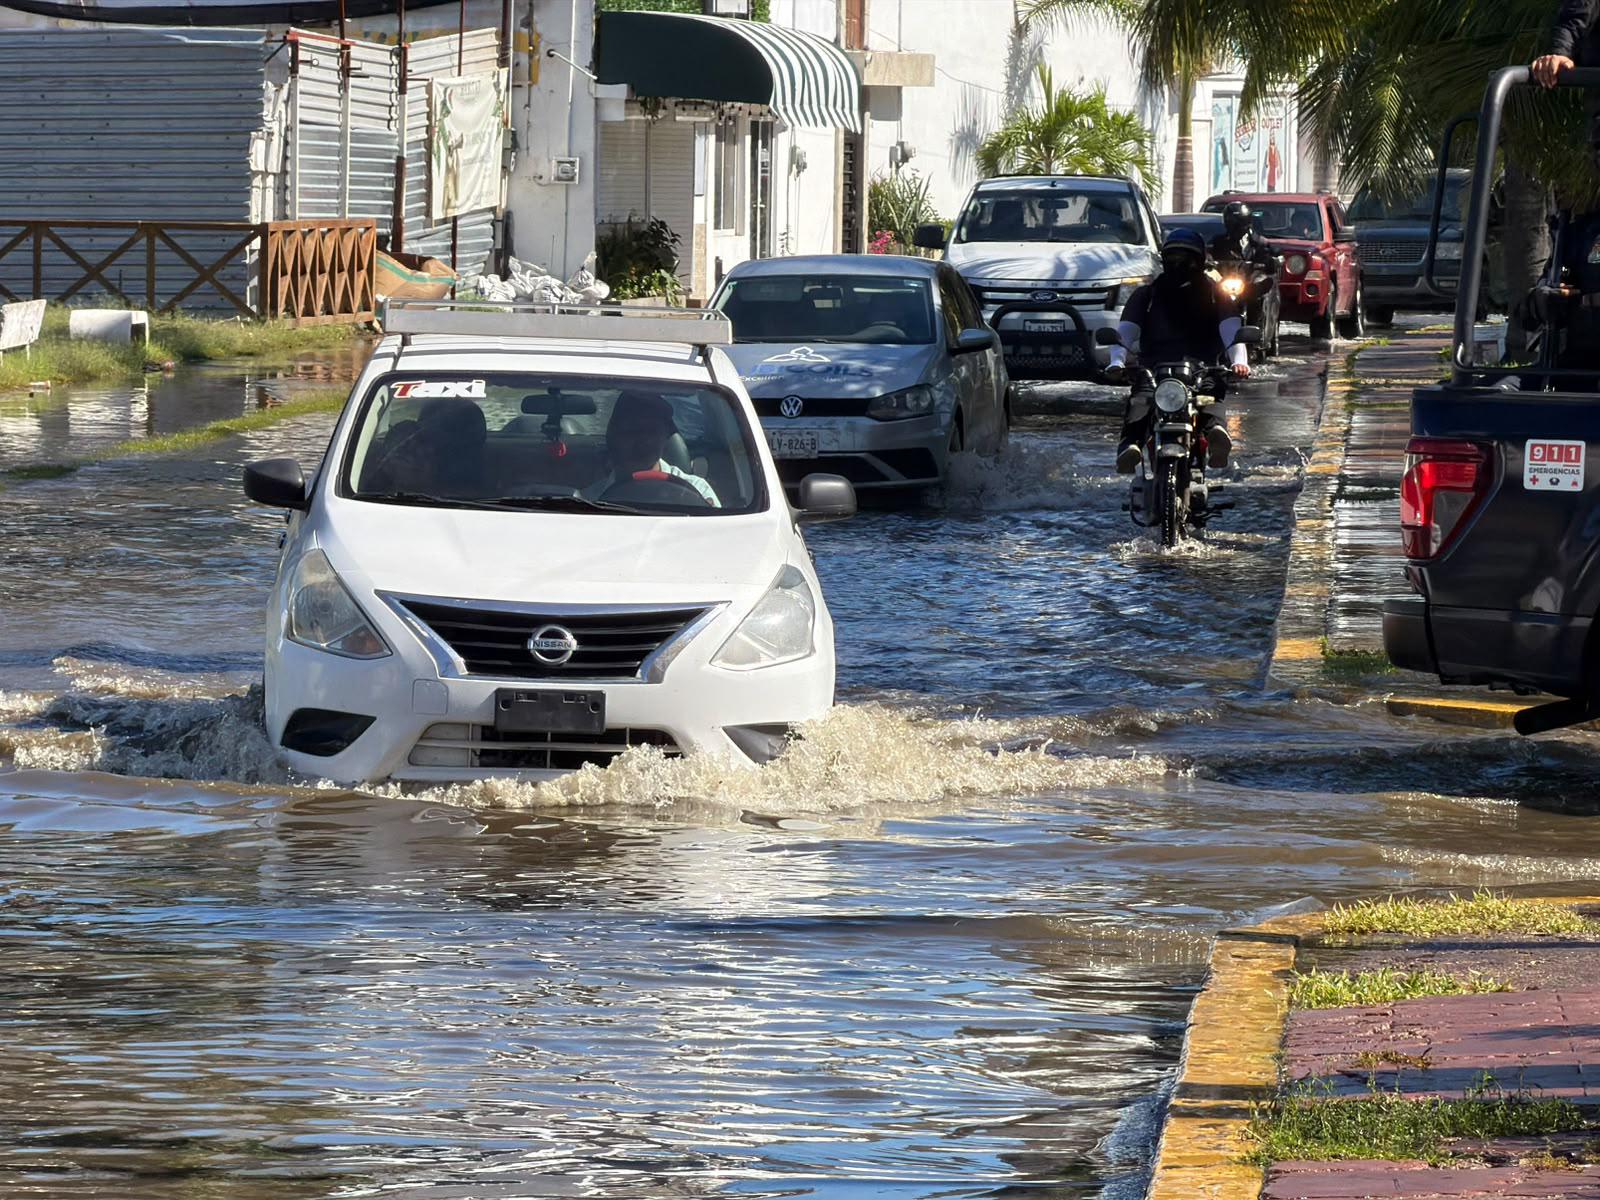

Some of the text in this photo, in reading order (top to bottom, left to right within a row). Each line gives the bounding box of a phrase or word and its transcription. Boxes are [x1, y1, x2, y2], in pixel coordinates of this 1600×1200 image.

[1532, 446, 1578, 461] 911
[1528, 467, 1581, 475] EMERGENCIAS
[532, 640, 572, 649] NISSAN
